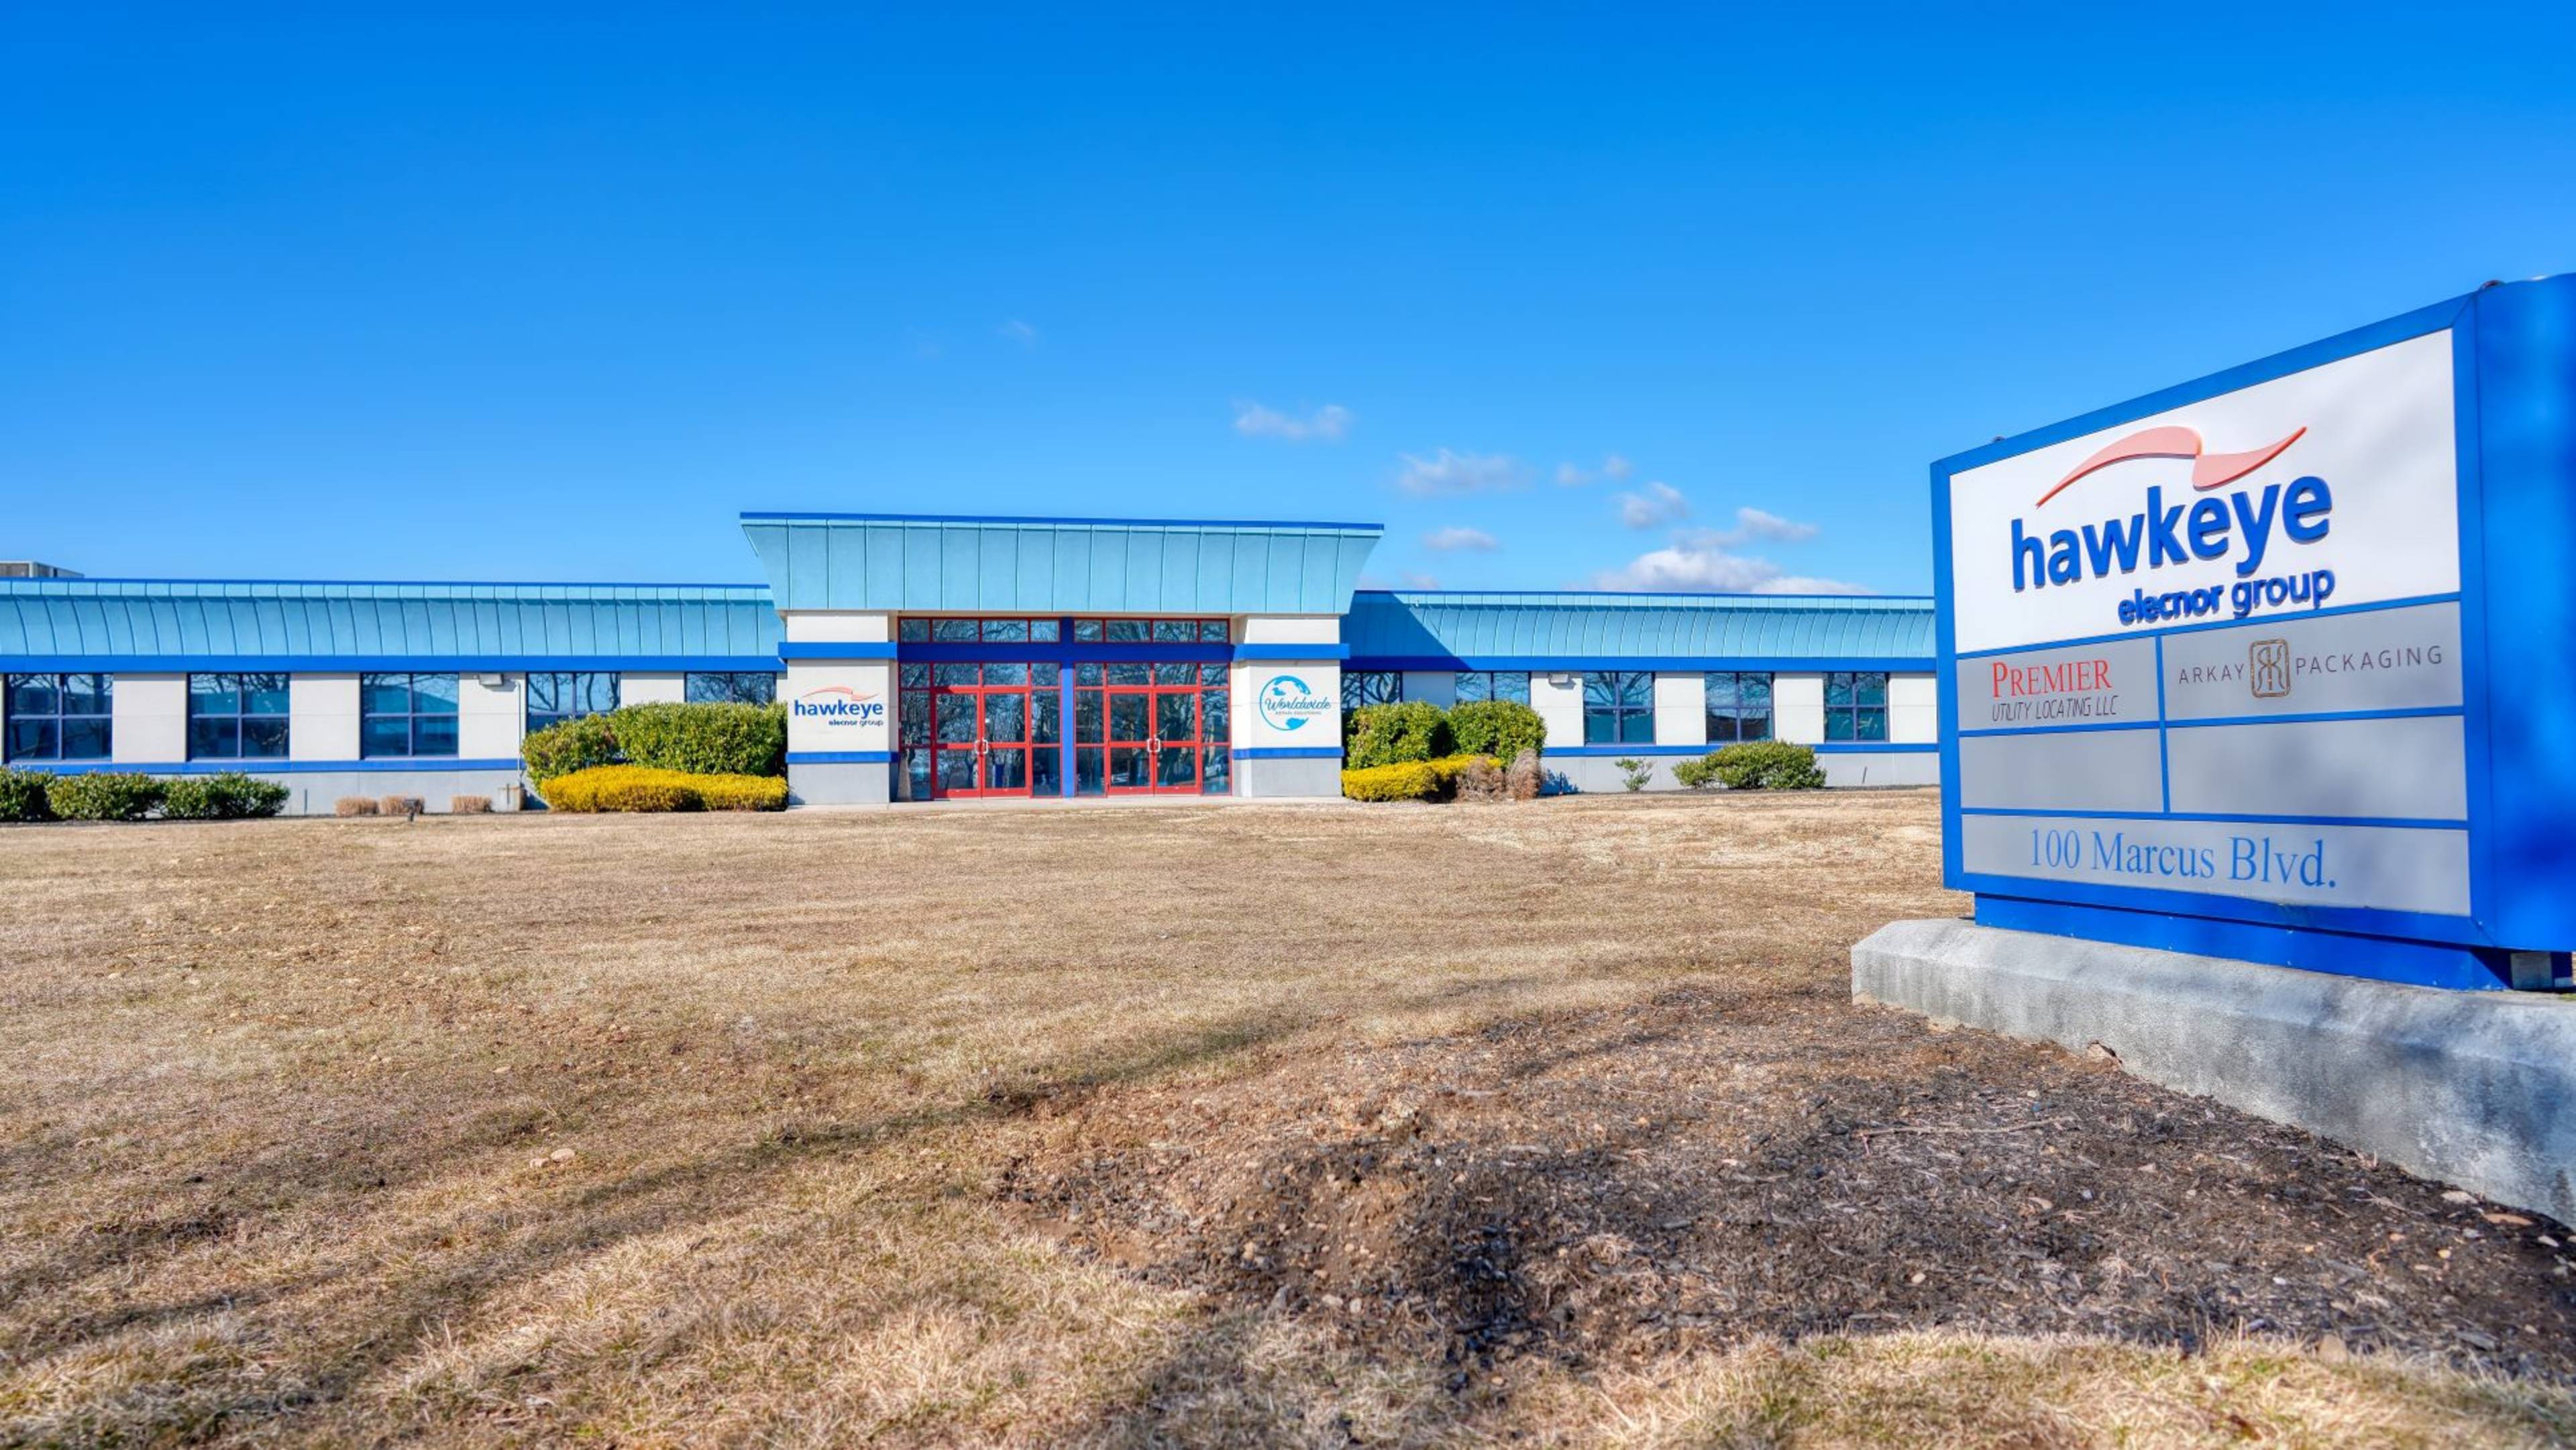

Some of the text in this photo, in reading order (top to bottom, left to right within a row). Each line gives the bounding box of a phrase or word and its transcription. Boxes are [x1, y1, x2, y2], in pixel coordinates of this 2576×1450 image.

[2012, 476, 2332, 592] hawkeye
[2118, 566, 2336, 625] elecnor group
[1991, 659, 2113, 698] PREMIER
[2178, 663, 2245, 685] ARKAY
[2295, 645, 2443, 676] PACKAGING
[794, 699, 883, 719] hawkeye
[1265, 696, 1331, 711] Worldwide
[1992, 695, 2119, 722] UTILITY LOCATING LLC
[2030, 829, 2337, 888] 100 Marcus Blvd.
